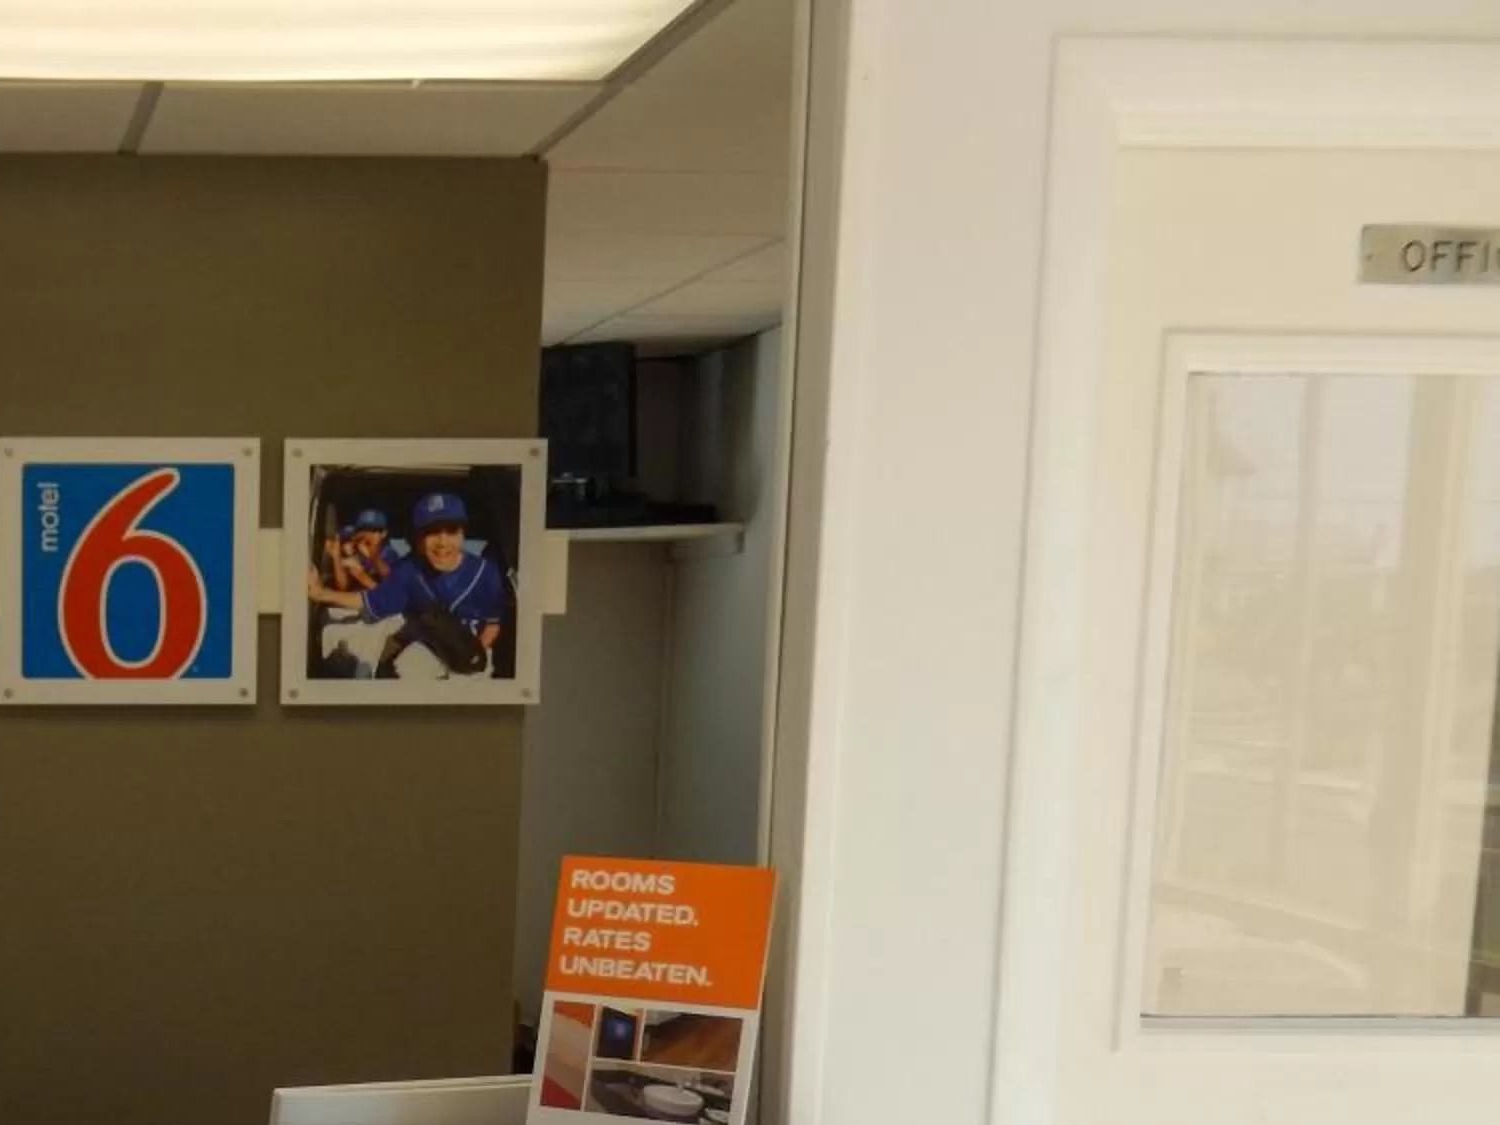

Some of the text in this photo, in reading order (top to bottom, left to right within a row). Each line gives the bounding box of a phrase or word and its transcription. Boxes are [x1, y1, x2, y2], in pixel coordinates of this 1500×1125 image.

[1401, 240, 1500, 272] OFFI
[37, 468, 207, 681] motel 6
[571, 869, 676, 895] ROOMS
[567, 898, 699, 926] UPDATED.
[563, 927, 652, 952] RATES
[559, 954, 712, 986] UNBEATEN.
